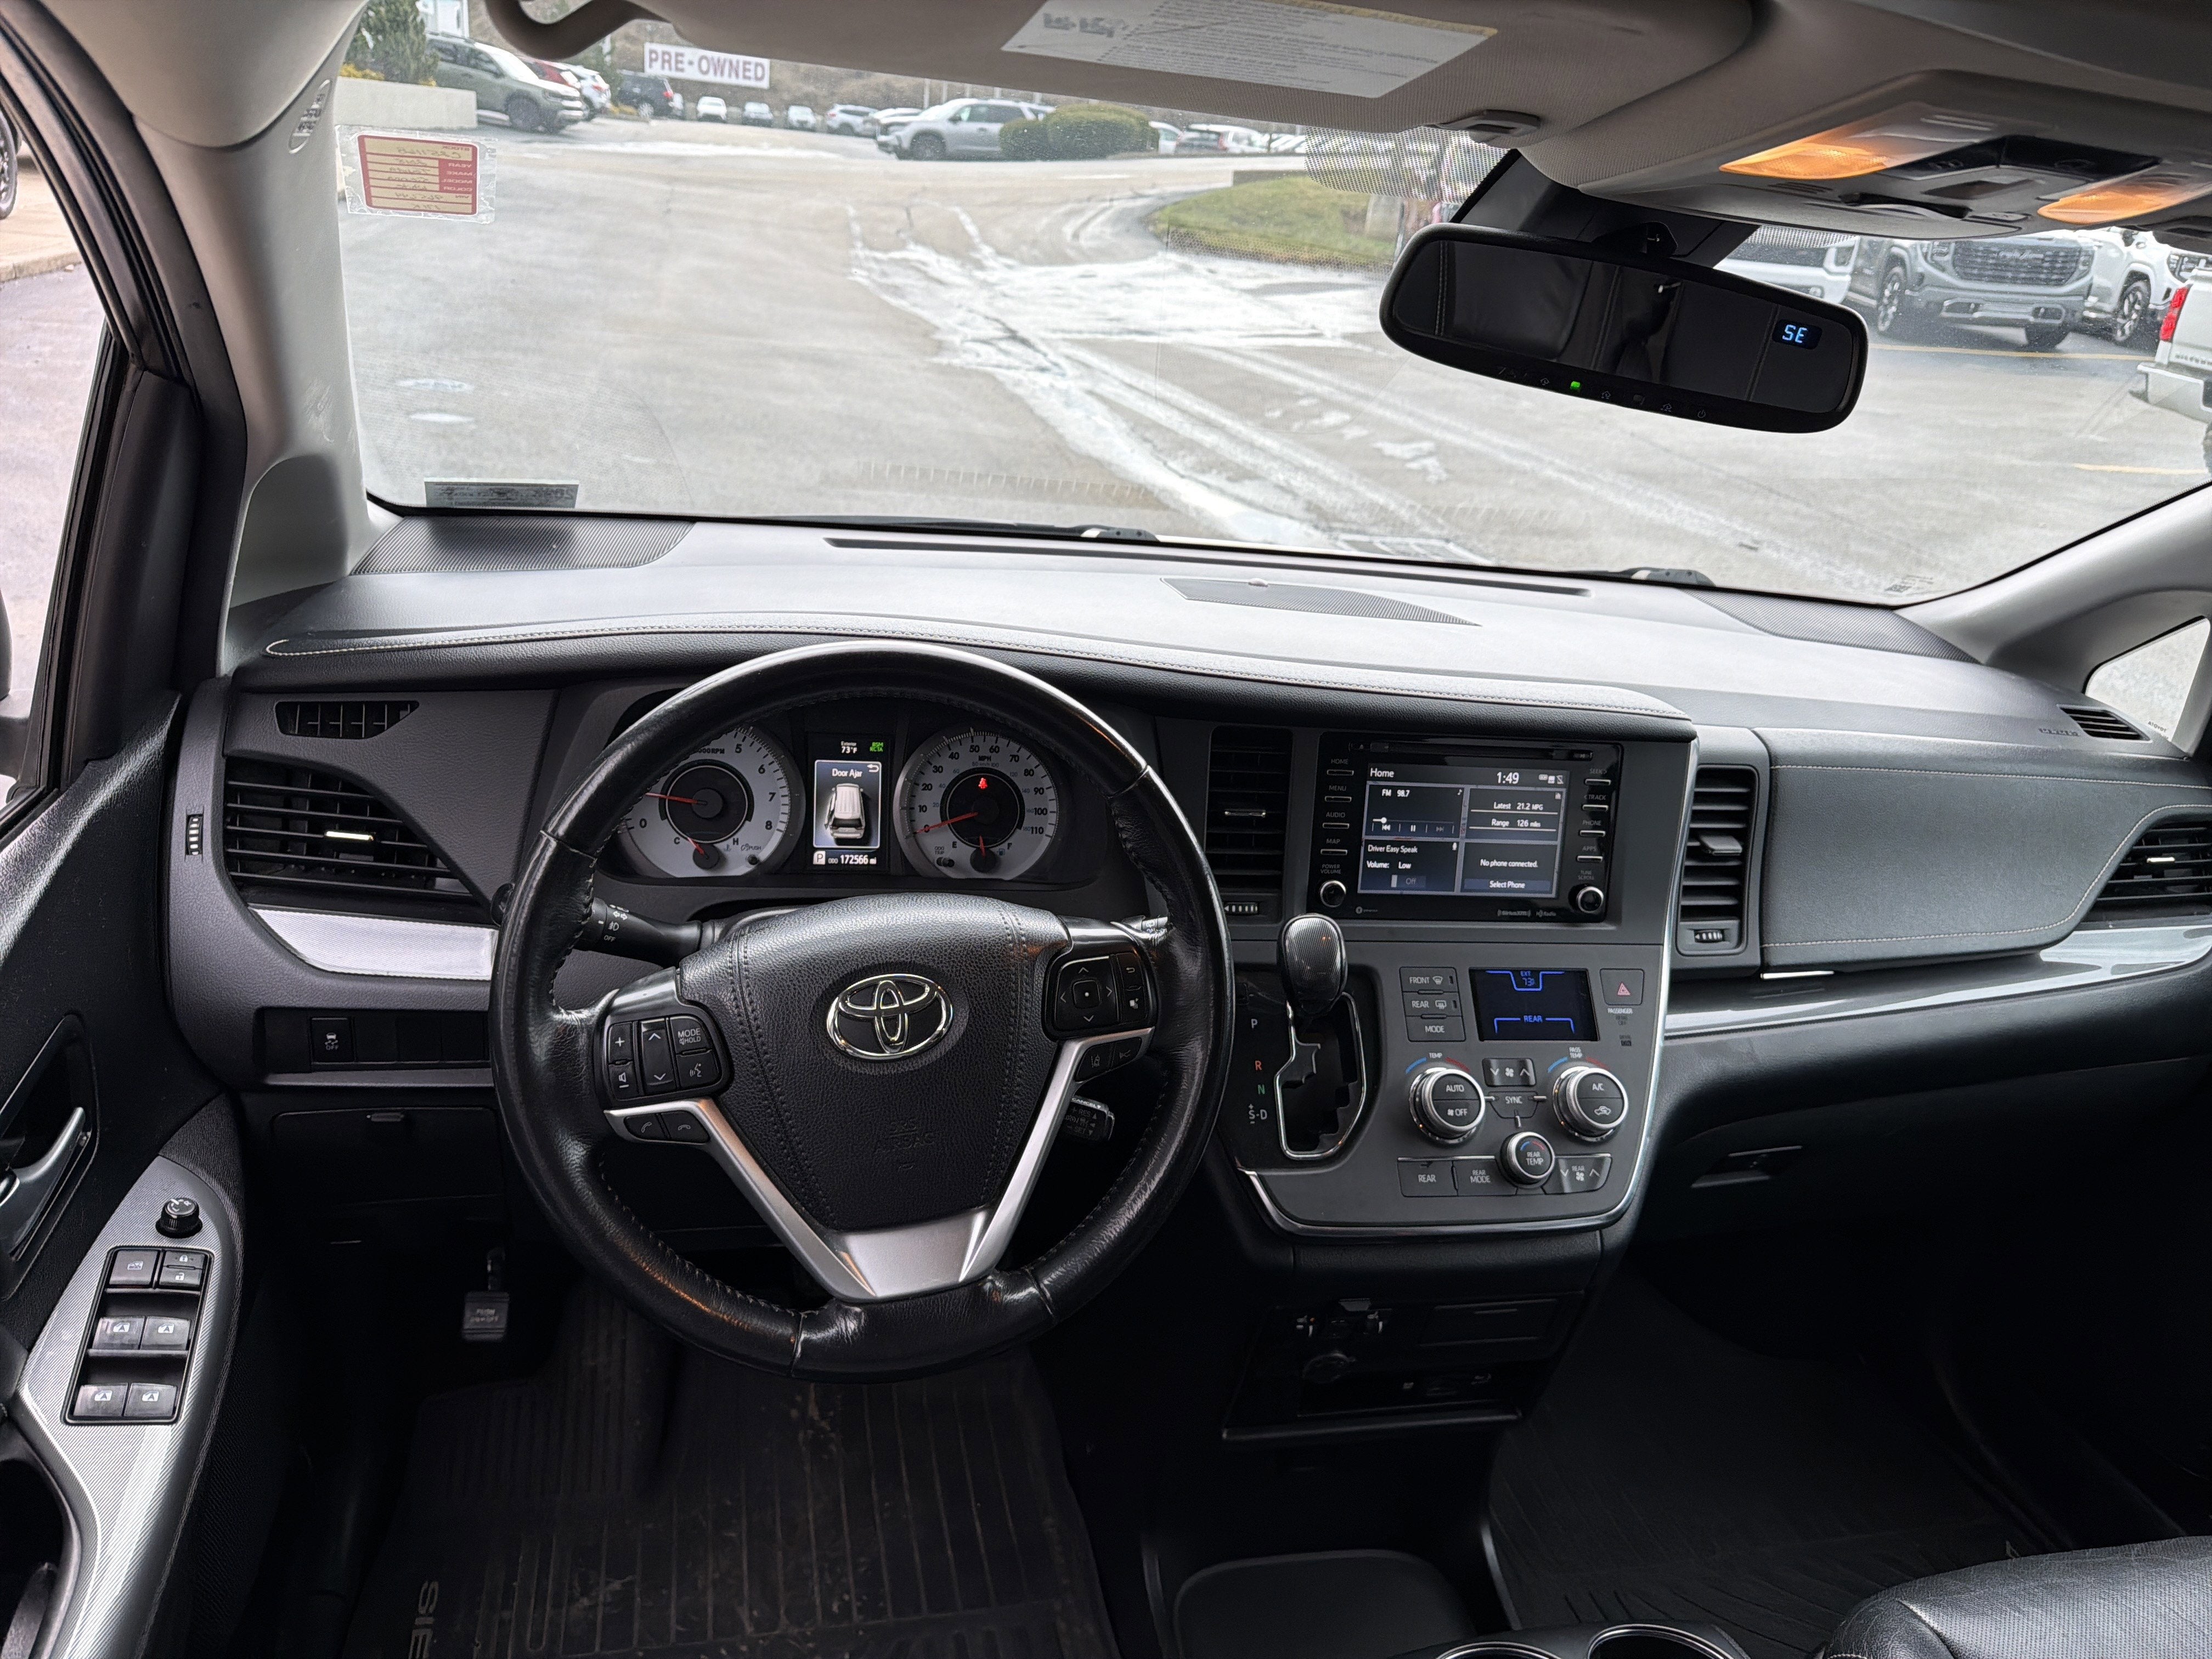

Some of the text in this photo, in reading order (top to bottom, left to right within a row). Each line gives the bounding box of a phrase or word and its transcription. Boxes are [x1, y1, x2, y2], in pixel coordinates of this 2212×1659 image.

[648, 48, 765, 82] PRE-OWNED
[1782, 324, 1808, 343] SE
[735, 743, 742, 754] 5
[969, 745, 980, 753] 50
[949, 752, 960, 760] 40
[1009, 754, 1020, 763] 70
[758, 764, 766, 774] 6
[832, 769, 862, 778] Door Ajar
[1024, 769, 1034, 777] 80
[1370, 768, 1394, 778] Home
[1497, 771, 1520, 784] 1:49
[921, 783, 933, 791] 20
[1034, 787, 1045, 795] 90
[769, 792, 776, 802] 7
[918, 805, 927, 813] 10
[1493, 802, 1511, 810] Latest
[1034, 808, 1048, 816] 100
[639, 818, 647, 828] 0
[765, 821, 773, 831] 8
[1491, 819, 1510, 827] Range
[1030, 826, 1044, 834] 110
[1386, 845, 1400, 854] Easy
[1400, 845, 1418, 854] Speak
[816, 854, 823, 862] P
[840, 854, 868, 865] 172566
[1490, 860, 1508, 868] phone
[1412, 1000, 1429, 1008] REAR
[1251, 1018, 1258, 1029] P
[678, 1028, 701, 1038] MODE
[685, 1036, 701, 1044] HOLD
[1255, 1060, 1262, 1071] R
[1257, 1084, 1266, 1094] N
[1071, 1097, 1097, 1109] CANCEL
[1525, 1158, 1544, 1166] TEMP
[1418, 1174, 1437, 1183] REAR
